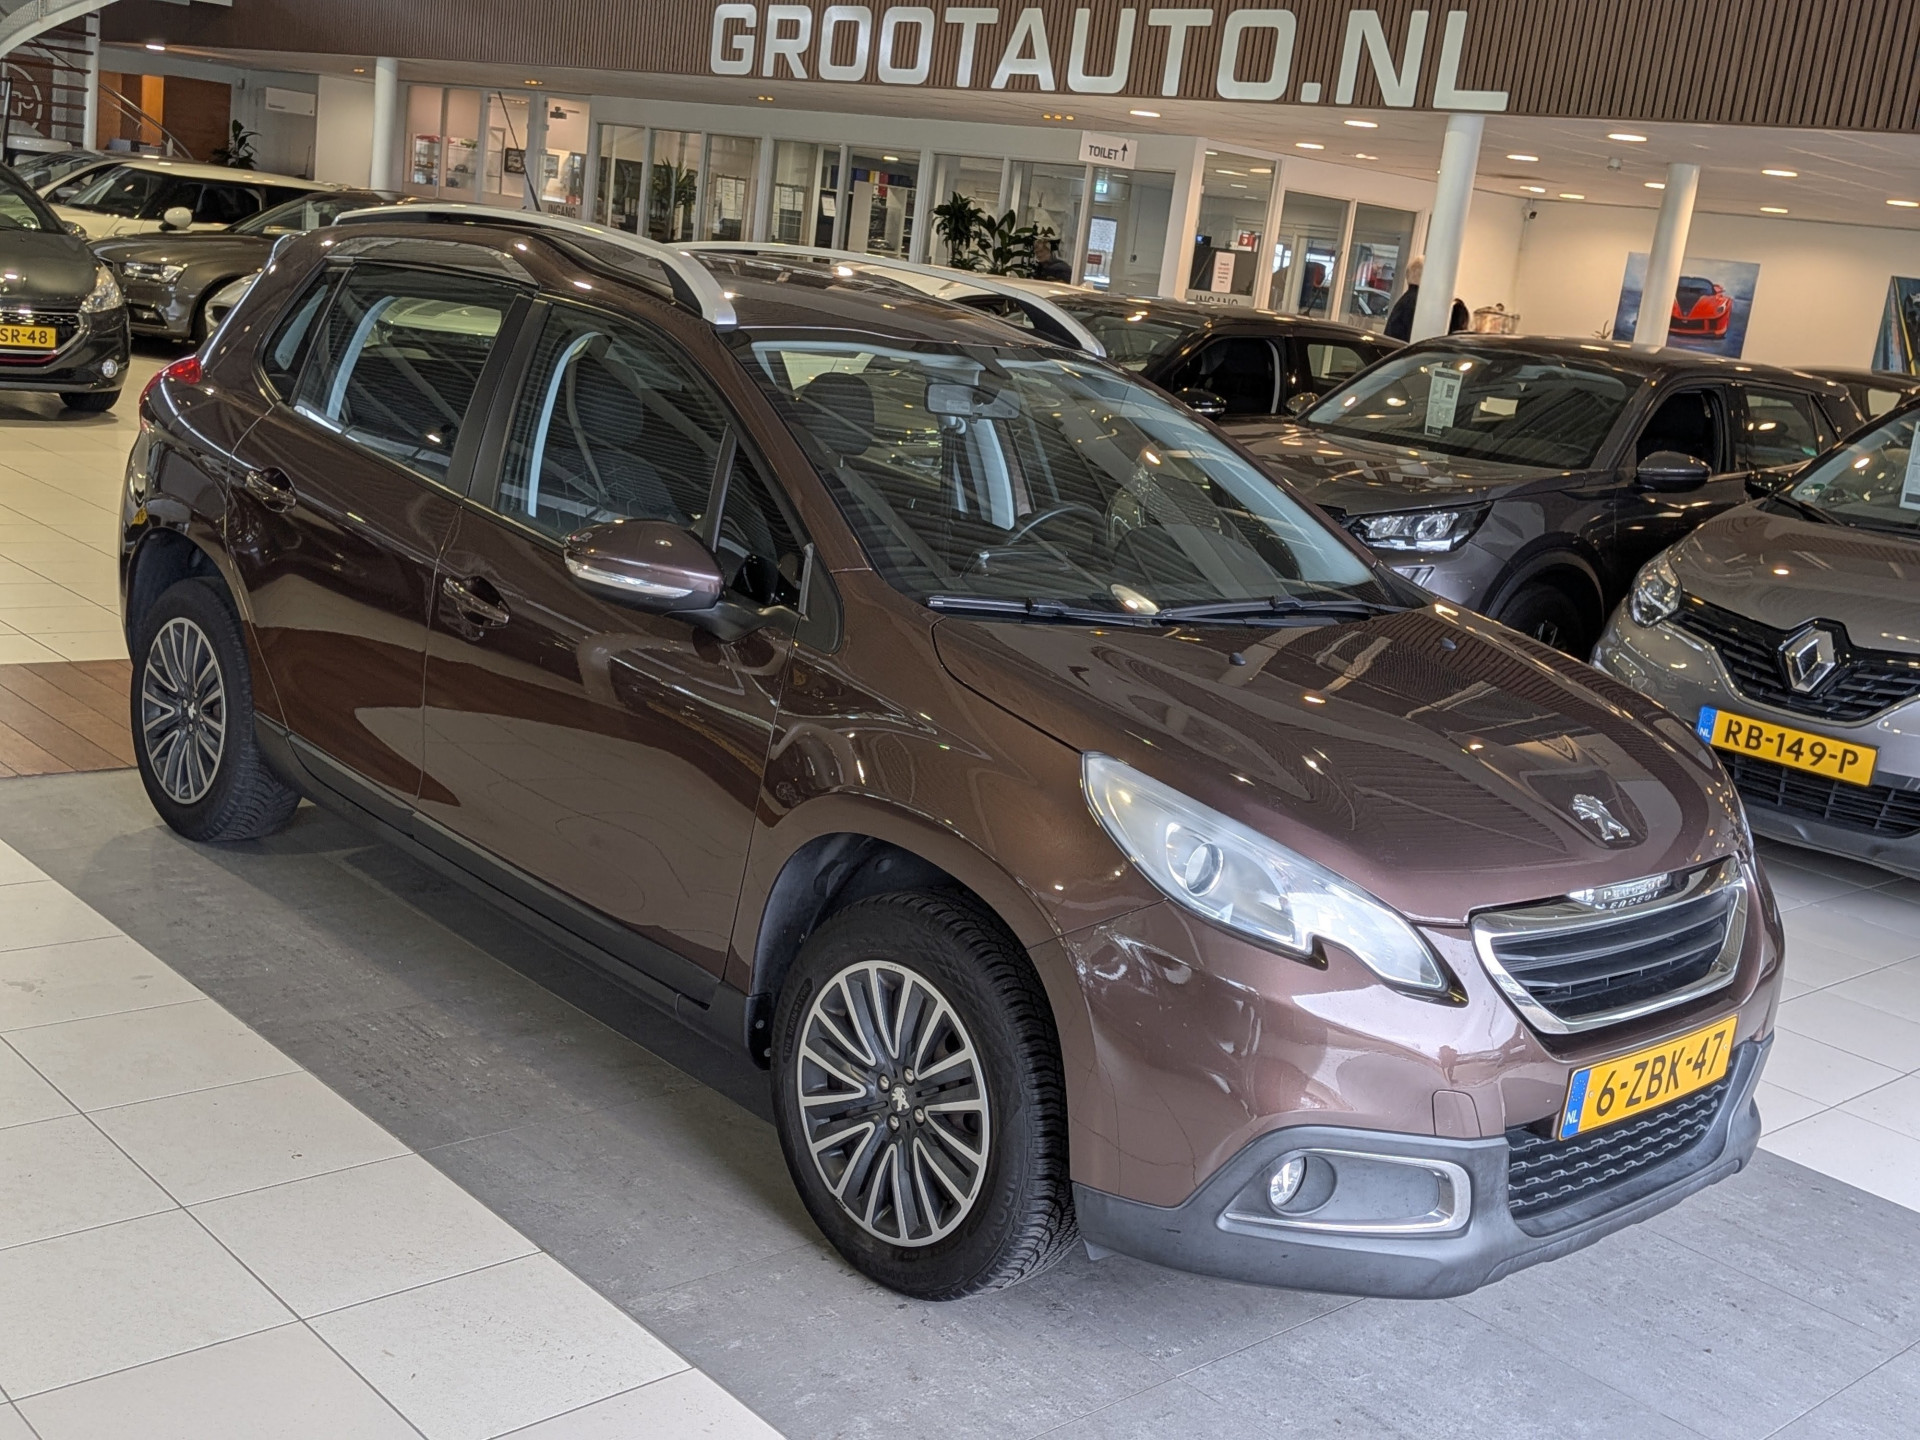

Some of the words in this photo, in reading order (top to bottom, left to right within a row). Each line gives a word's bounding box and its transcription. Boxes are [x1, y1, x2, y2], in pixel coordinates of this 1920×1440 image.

[711, 4, 1508, 112] GROOTAUTO.NL
[1089, 145, 1119, 160] TOILET
[547, 204, 576, 218] INGANG
[1699, 727, 1711, 738] NL
[1724, 719, 1859, 774] RB-149-P
[1565, 1111, 1578, 1125] NL
[1597, 1030, 1726, 1117] 6-ZBK-47
